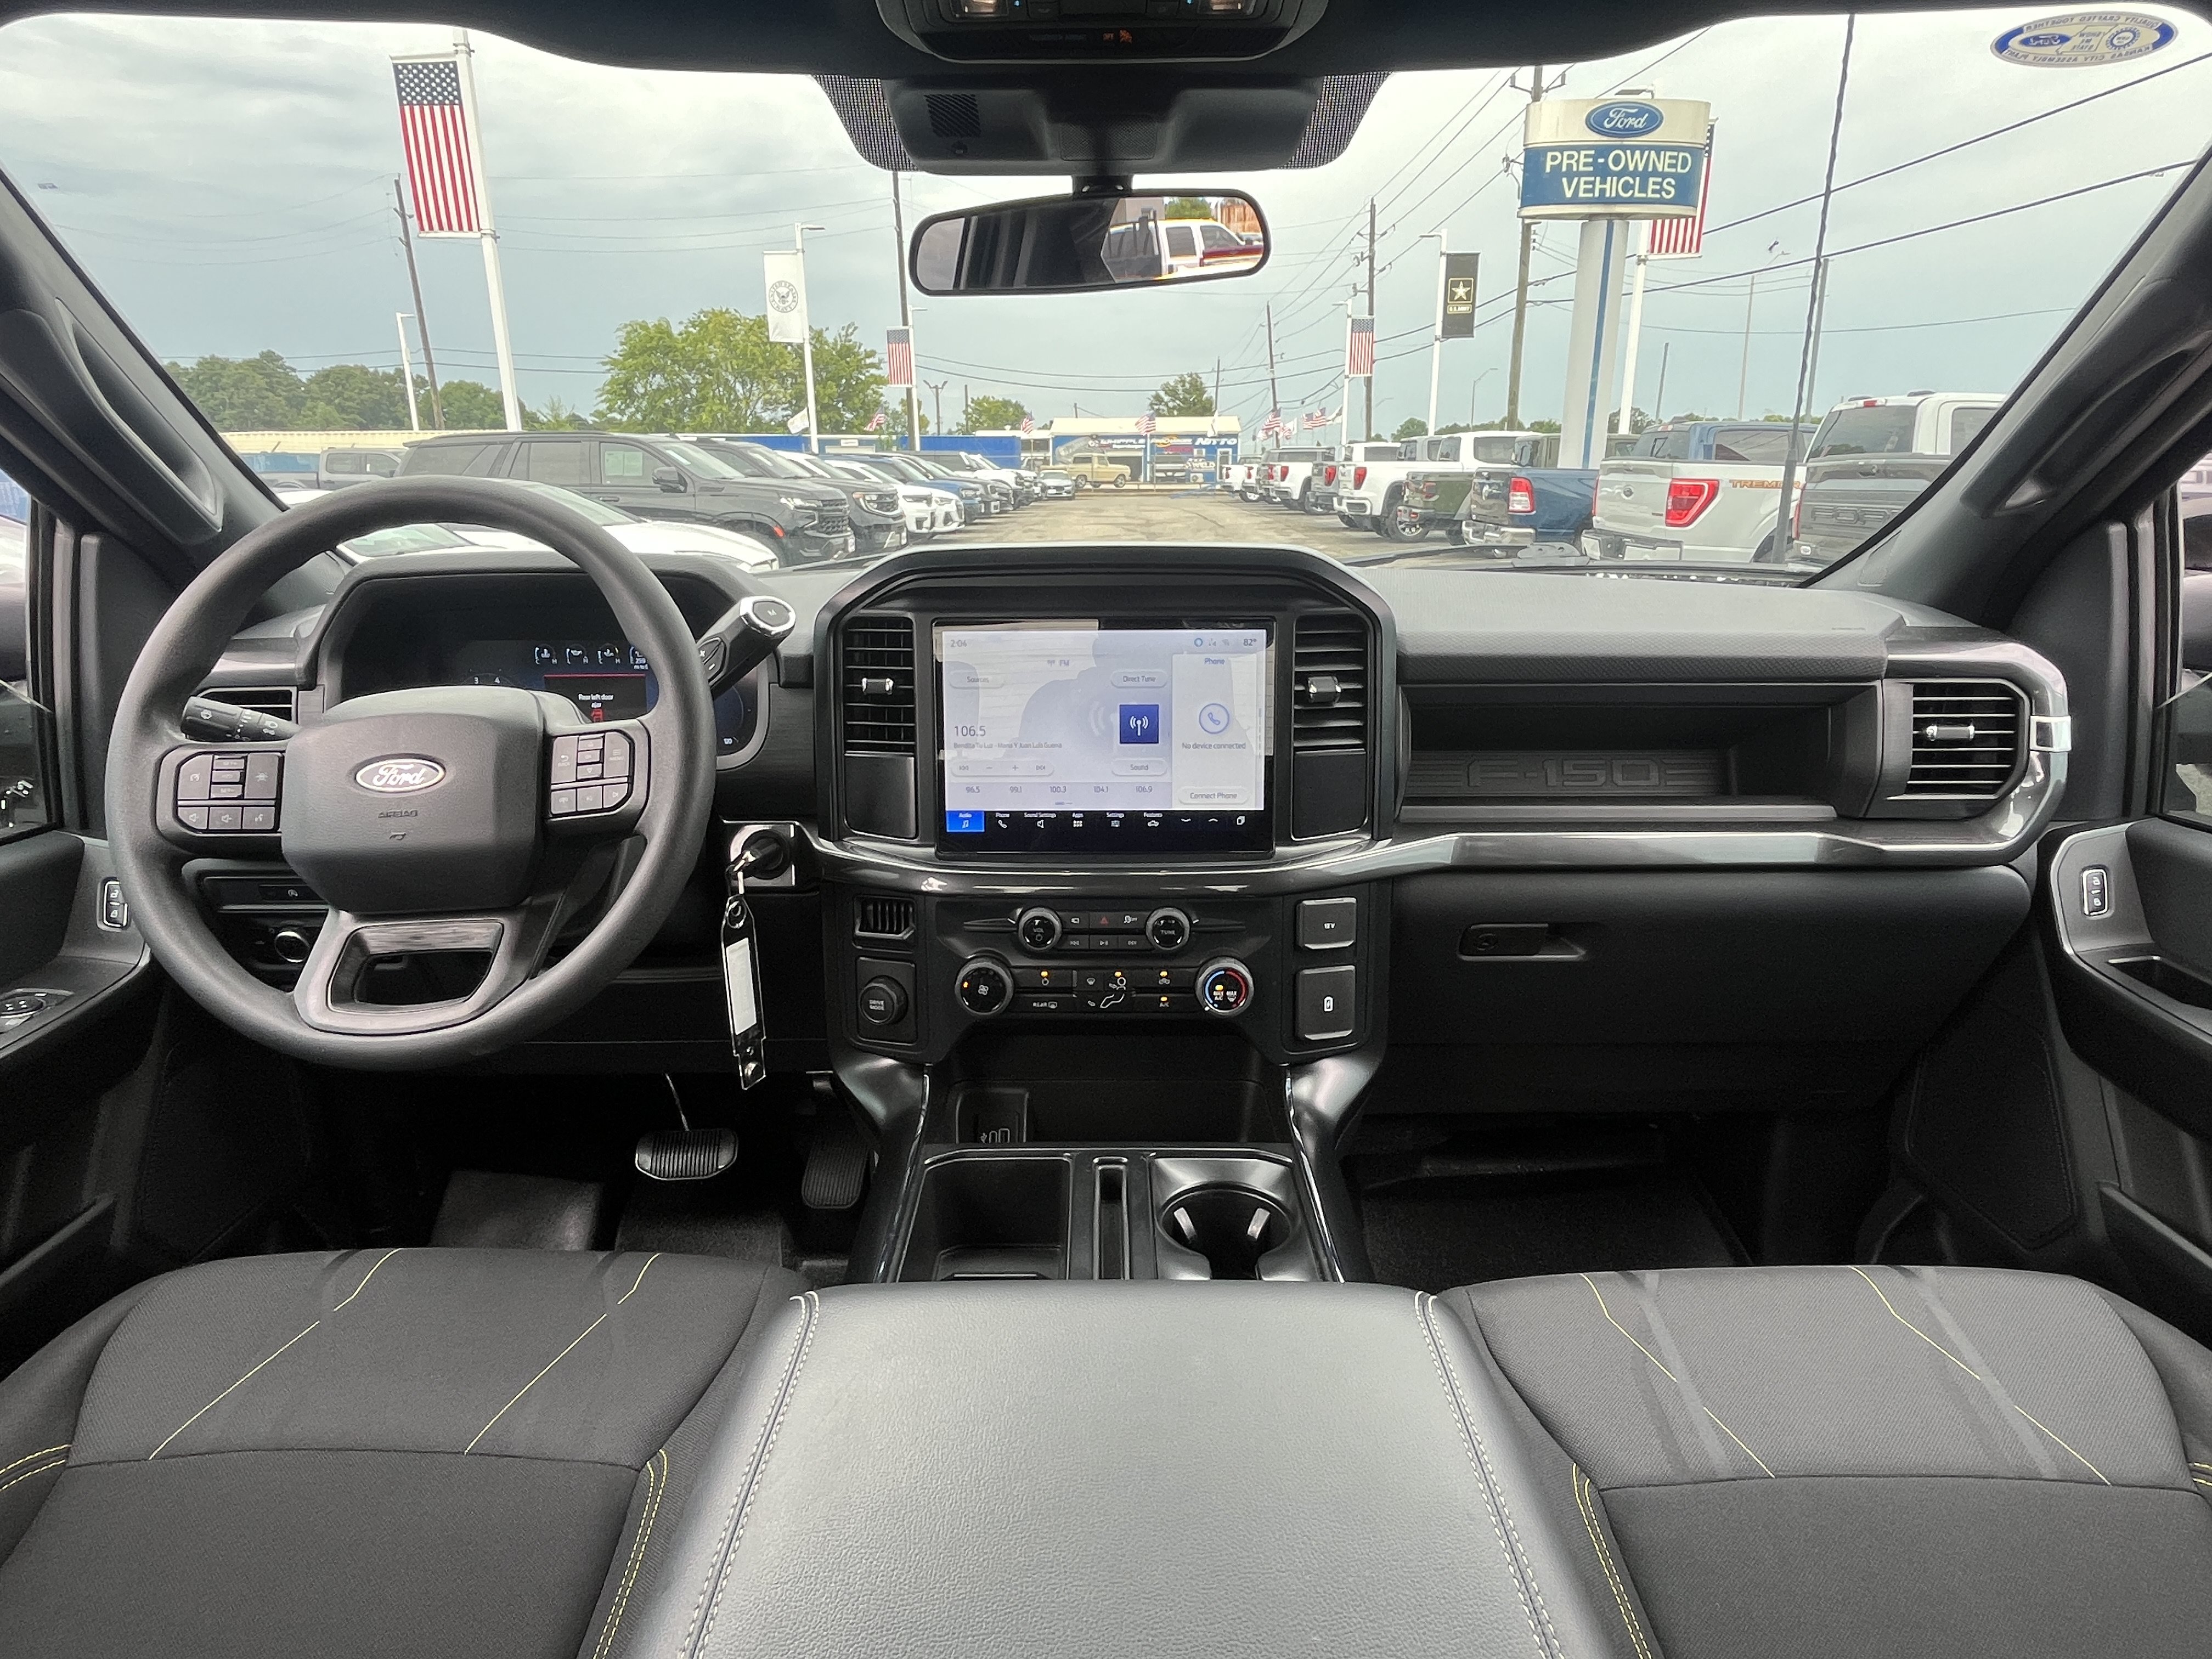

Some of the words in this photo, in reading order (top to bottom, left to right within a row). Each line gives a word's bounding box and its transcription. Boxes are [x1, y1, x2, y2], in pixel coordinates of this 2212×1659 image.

[1603, 108, 1649, 129] Ford
[1561, 176, 1676, 200] VEHICLES
[1811, 505, 1900, 525] FOR
[950, 639, 968, 648] 2:04
[474, 676, 479, 685] 3
[954, 725, 986, 737] 106.5
[373, 763, 427, 786] Ford
[1468, 759, 1660, 787] F-150
